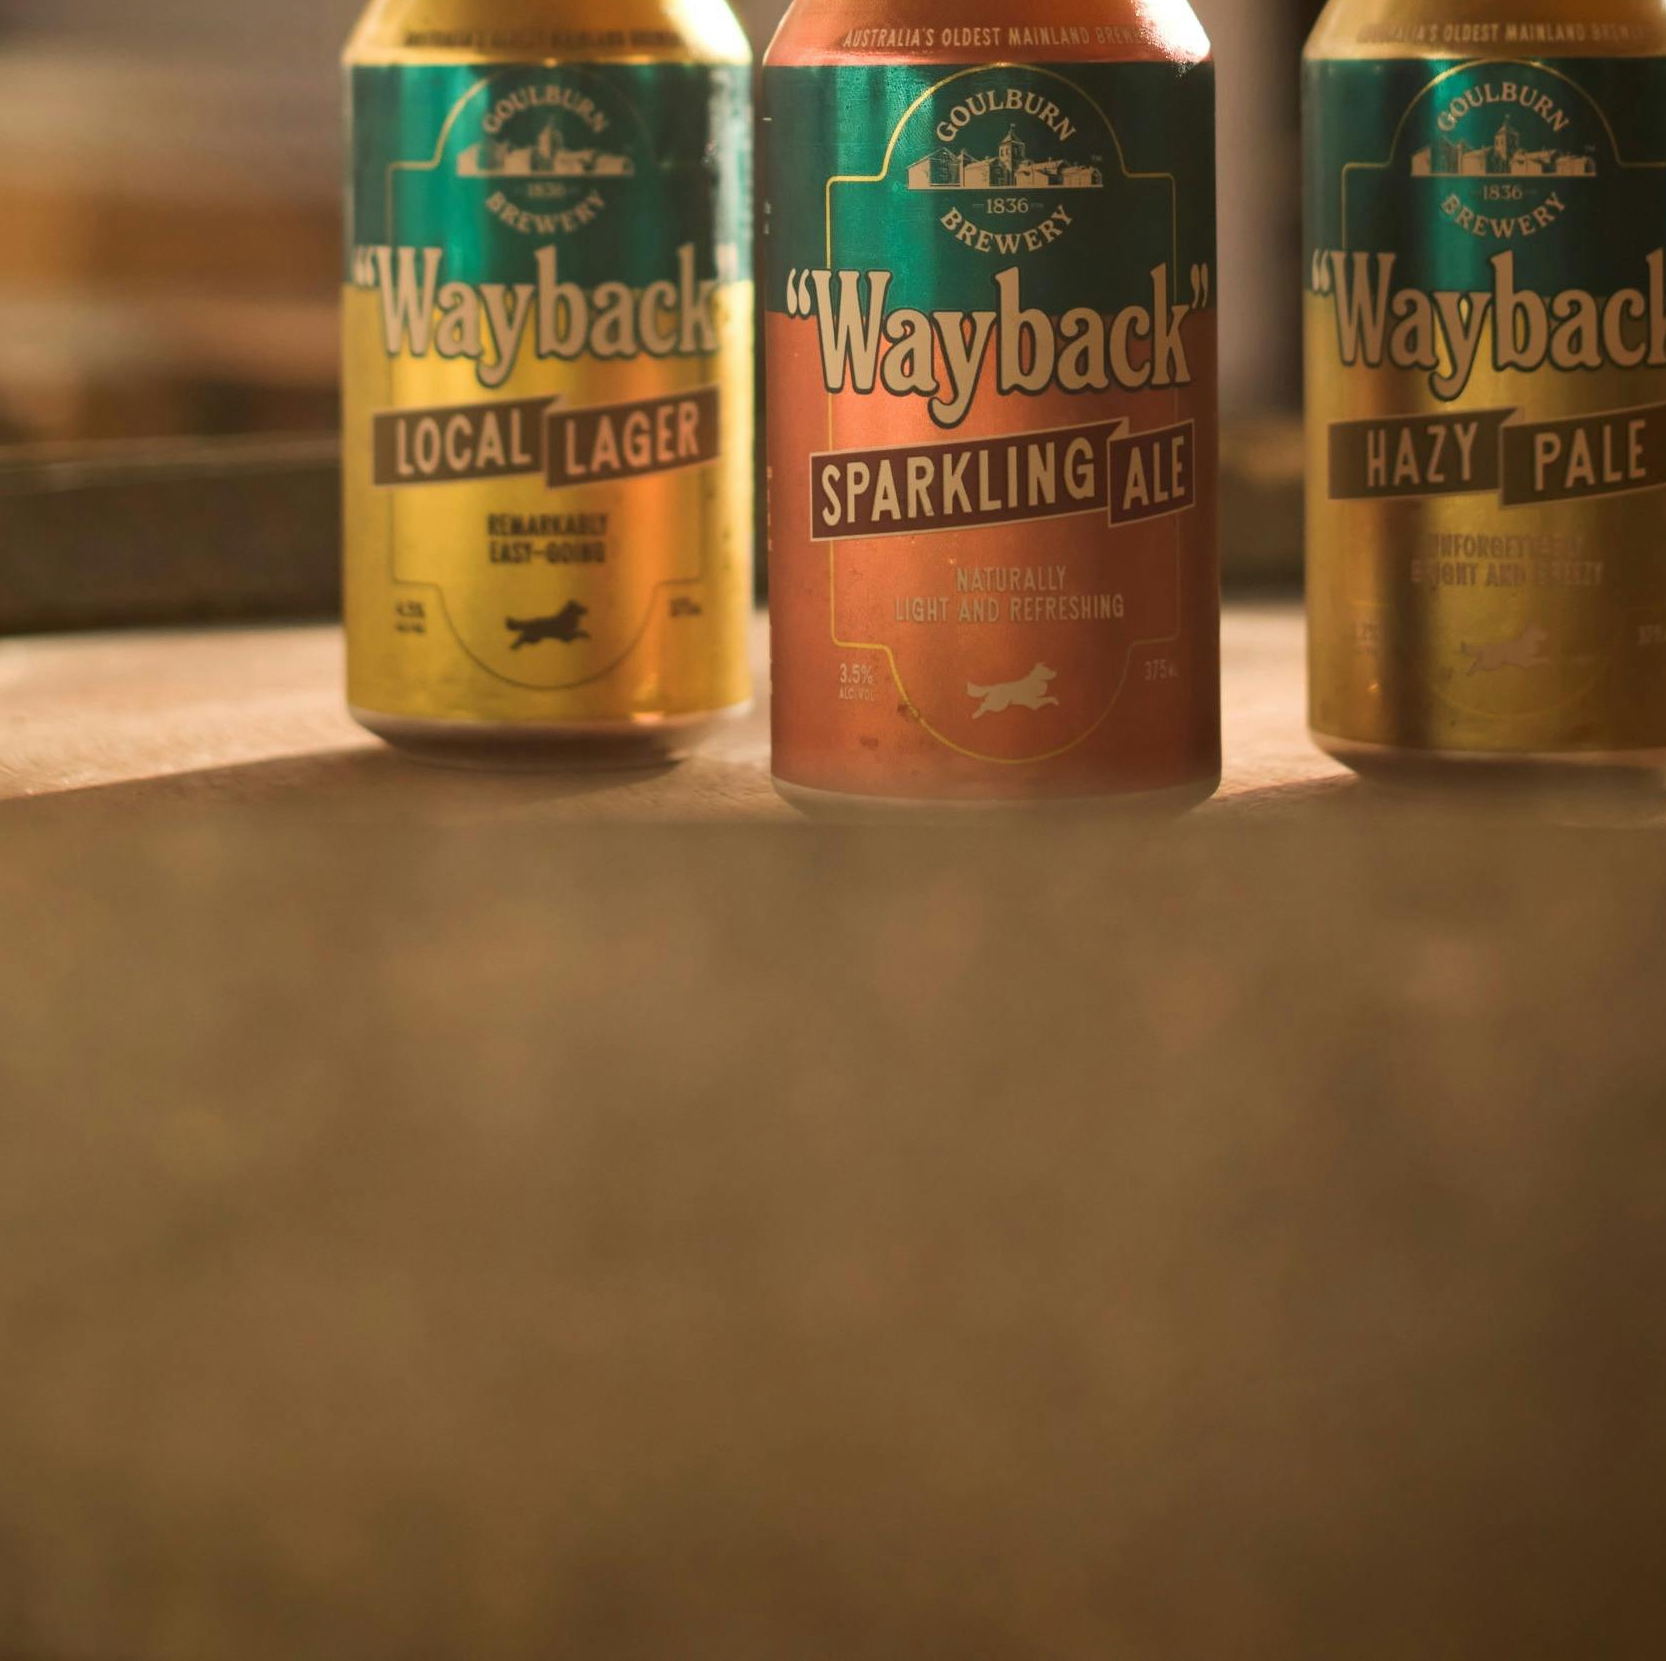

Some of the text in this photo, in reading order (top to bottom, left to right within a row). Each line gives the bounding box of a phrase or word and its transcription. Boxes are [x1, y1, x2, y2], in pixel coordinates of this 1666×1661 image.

[844, 26, 1145, 48] AUSTRALIA'S OLDEST MAINLAND BREW
[1445, 22, 1499, 41] OLDEST
[1504, 22, 1585, 42] MAINLAND
[1592, 22, 1645, 42] BREW
[483, 85, 610, 134] GOULBURN
[936, 89, 1077, 142] GOULBURN
[1436, 82, 1570, 133] GOULBURN
[986, 198, 1030, 214] 1836
[1482, 185, 1523, 201] 1836
[485, 191, 606, 234] BREWERY
[940, 204, 1074, 255] BREWERY
[1440, 191, 1568, 238] BREWERY
[786, 263, 1209, 427] “Wayback”
[396, 401, 700, 475] LOCAL LAGER
[1366, 419, 1647, 491] HAZY PALE
[821, 437, 1095, 527] SPARKLING
[1123, 436, 1185, 511] ALE
[488, 513, 609, 536] REMARKABLY
[489, 541, 607, 565] EASY-GOING
[956, 565, 1067, 592] NATURALLY
[1485, 562, 1527, 587] AND
[895, 594, 1124, 622] LIGHT AND REFRESHING
[839, 663, 873, 685] 3.5%
